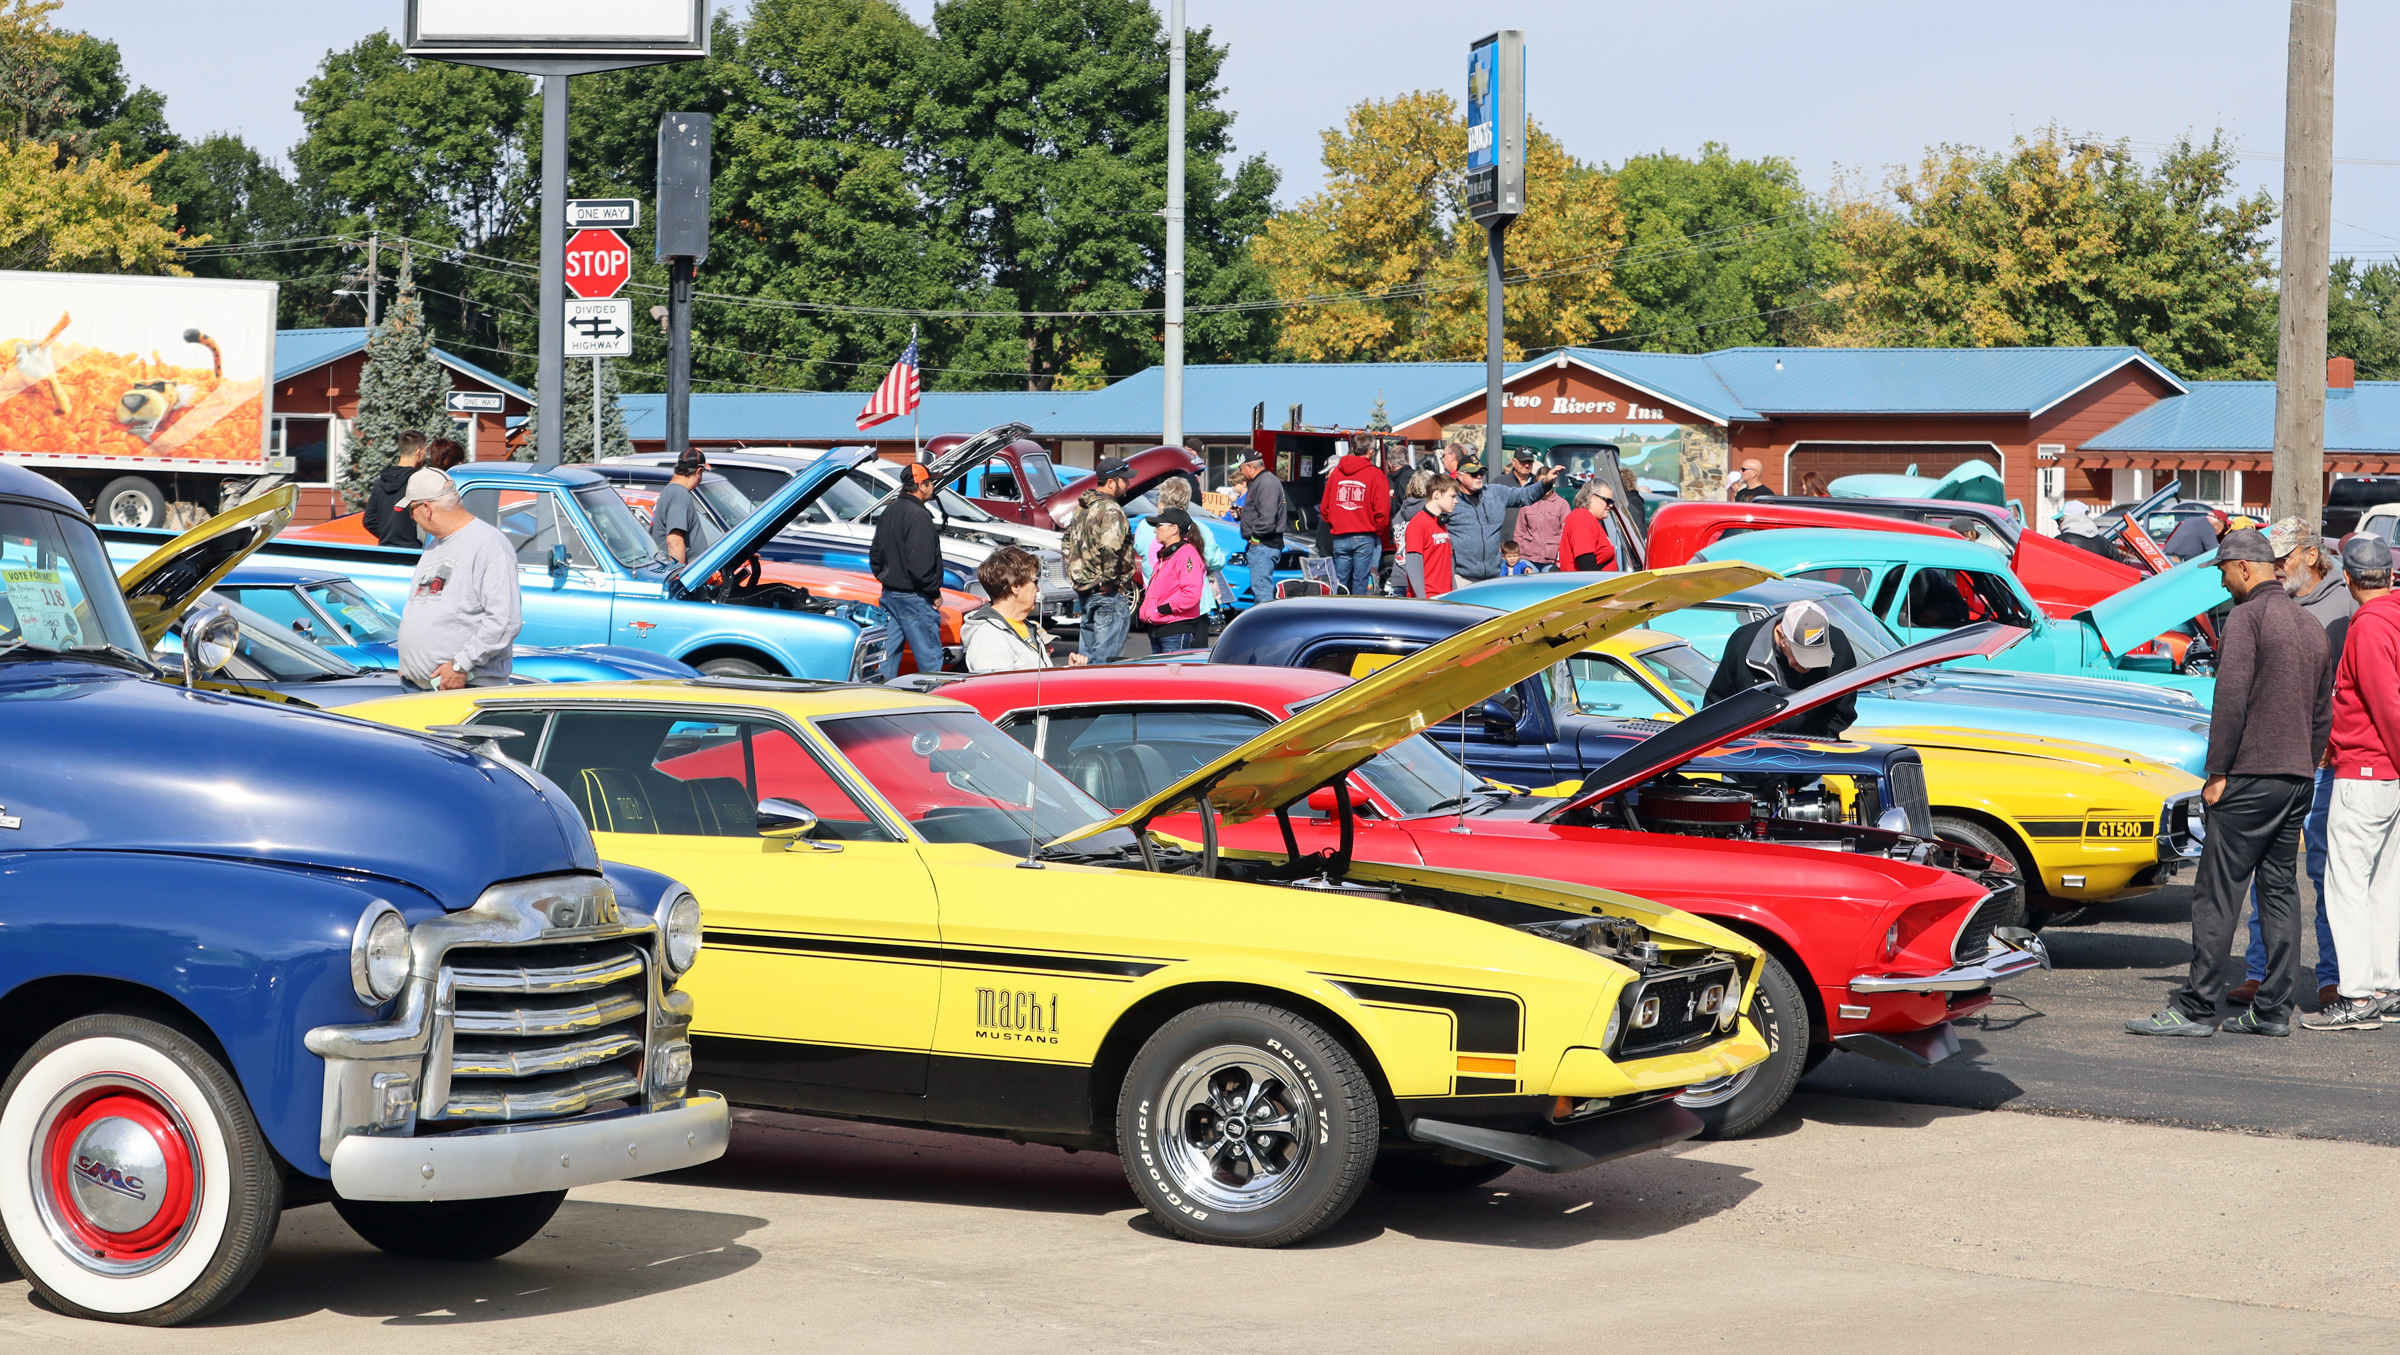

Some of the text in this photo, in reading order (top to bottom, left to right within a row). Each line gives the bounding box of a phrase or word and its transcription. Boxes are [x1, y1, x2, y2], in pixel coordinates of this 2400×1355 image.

[577, 207, 626, 219] ONE WAY
[566, 250, 626, 277] STOP
[575, 305, 617, 314] DIVIDED
[572, 341, 620, 350] HIGHWAY
[463, 398, 479, 406] ONE
[1502, 392, 1665, 420] Two Rivers Inn
[8, 571, 28, 581] VOTE
[29, 571, 42, 580] FOR
[41, 588, 66, 608] 118
[2098, 821, 2142, 837] GT500
[550, 896, 619, 928] GMC
[1048, 993, 1060, 1035] 1
[975, 1030, 1059, 1045] MUSTANG
[1769, 1021, 1780, 1053] T/A
[1266, 1038, 1330, 1146] Radial T/A
[1138, 1099, 1209, 1222] BFGoodrich
[78, 1155, 144, 1192] GMC
